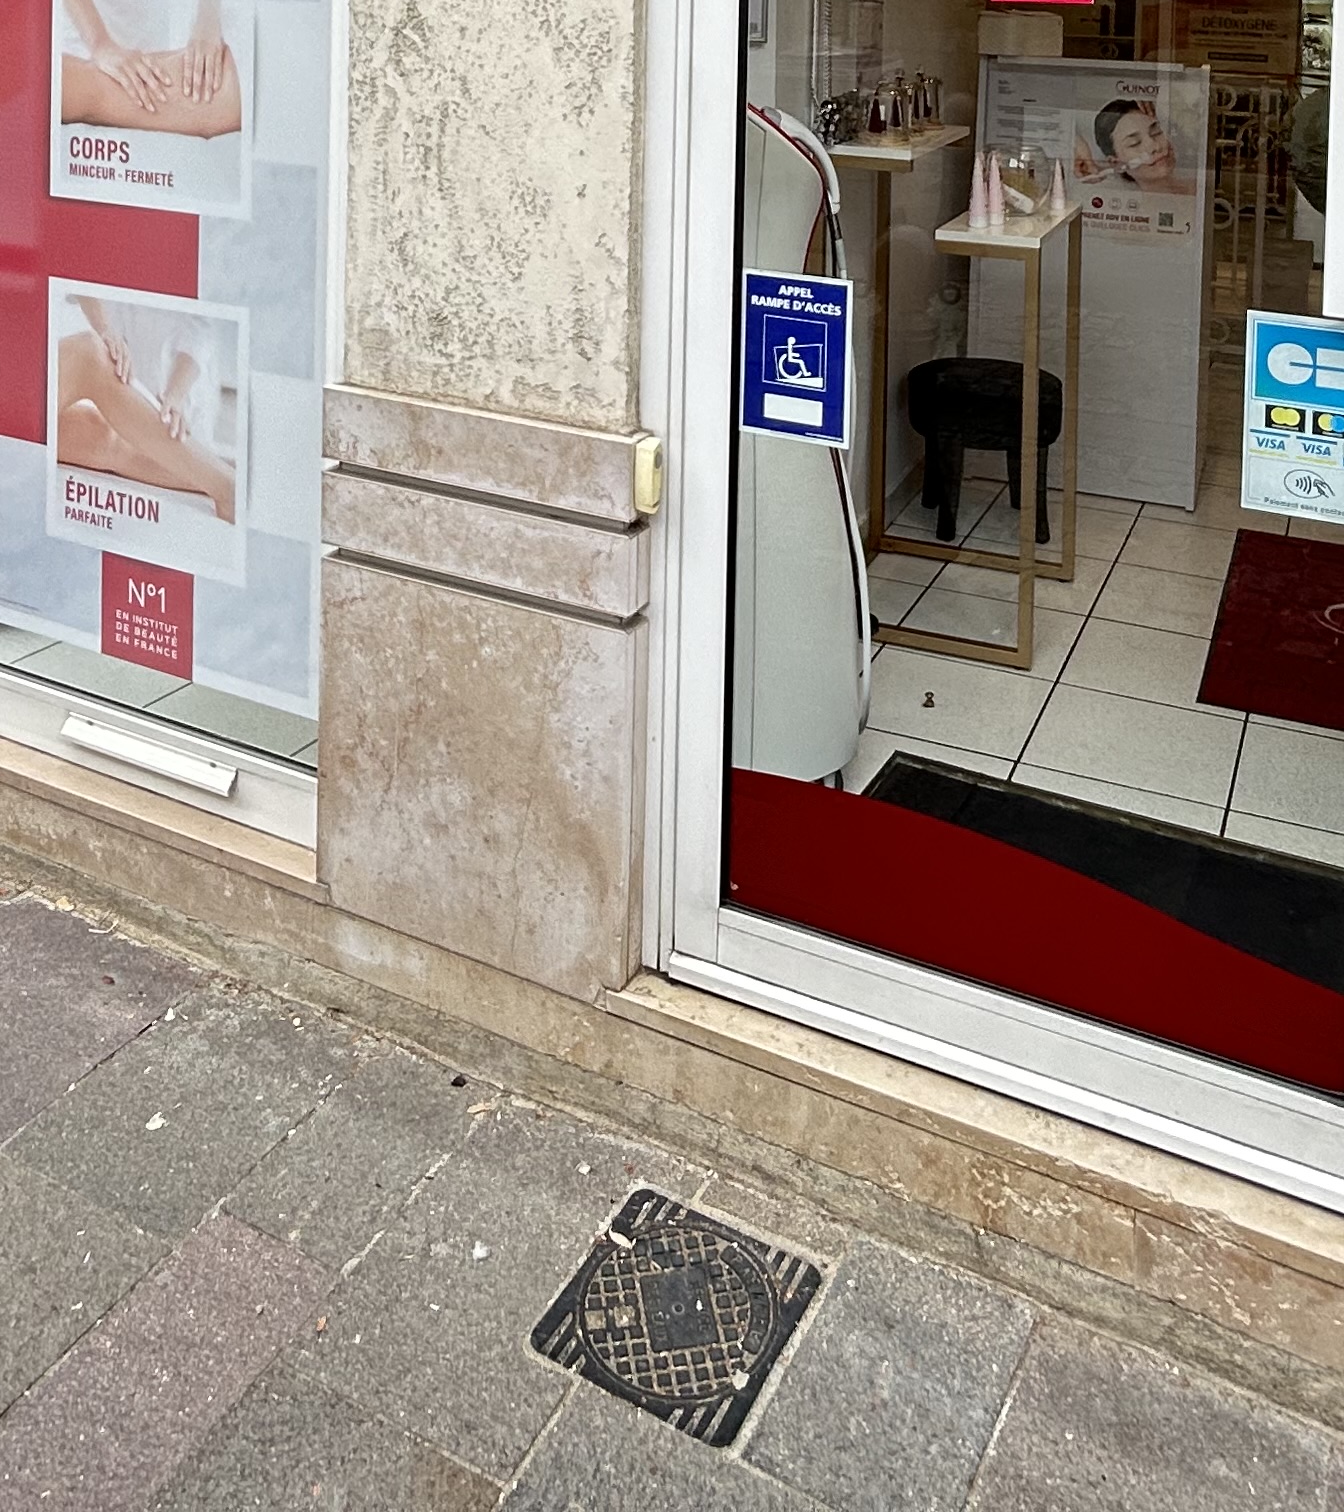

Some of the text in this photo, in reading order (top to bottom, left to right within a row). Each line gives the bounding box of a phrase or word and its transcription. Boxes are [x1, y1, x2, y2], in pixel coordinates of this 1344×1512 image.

[69, 135, 131, 165] CORPS
[68, 162, 117, 182] MINCEUR
[124, 167, 175, 188] FERMETÉ
[751, 294, 790, 310] RAMPE
[777, 284, 814, 299] APPEL
[1255, 436, 1332, 457] VISA VISA
[64, 474, 160, 524] ÉPILATION
[63, 506, 113, 531] PARFAITE
[115, 609, 179, 636] EN INSTITUT
[115, 620, 130, 633] DE
[114, 633, 178, 661] EN FRANCE
